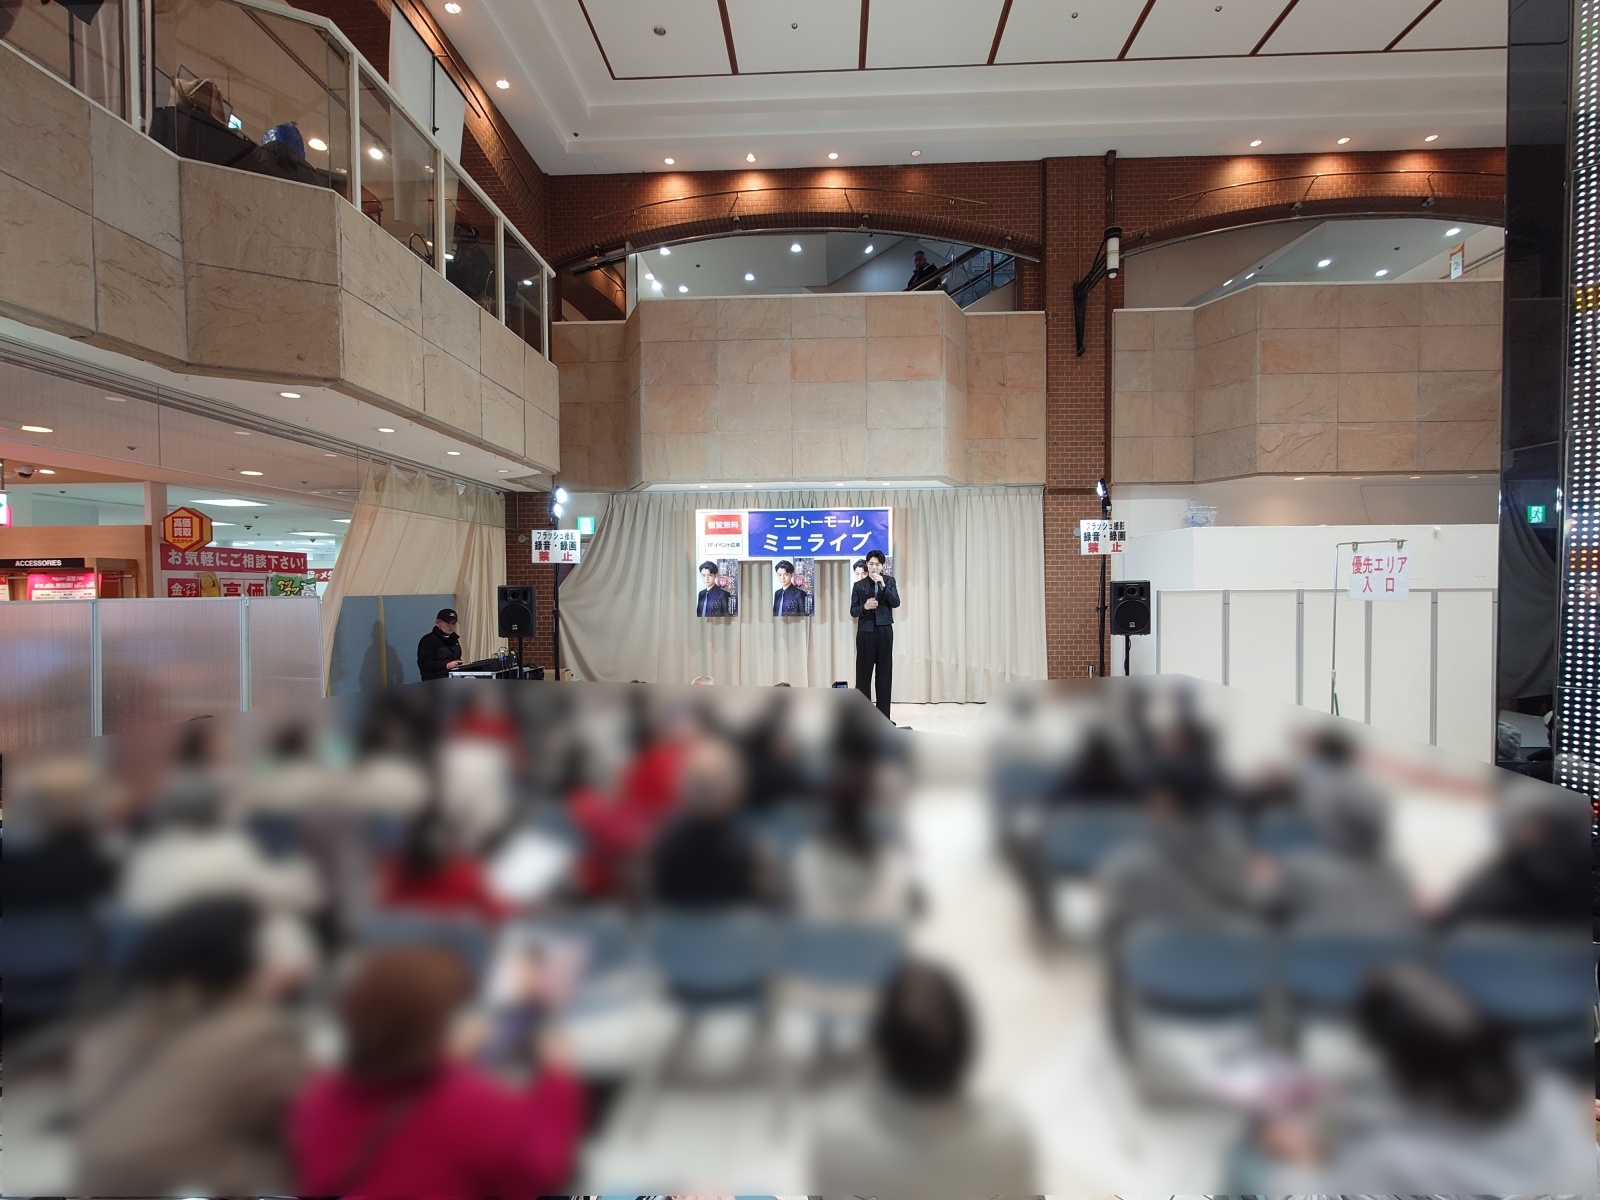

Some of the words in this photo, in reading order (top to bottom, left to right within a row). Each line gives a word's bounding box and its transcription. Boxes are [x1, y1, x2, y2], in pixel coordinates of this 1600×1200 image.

[774, 515, 864, 528] ニットーモール
[1086, 521, 1125, 530] フラッシュ撮影
[536, 532, 576, 540] フラッシュ撮影
[763, 531, 872, 552] ミニライブ
[1083, 531, 1126, 542] 録音・録画
[534, 541, 577, 551] 録音・録画
[1087, 542, 1123, 553] 禁止
[168, 549, 305, 569] お気軽にご相談下さい!
[538, 551, 573, 561] 禁止
[1352, 556, 1408, 574] 優先エリア
[1363, 576, 1394, 593] 入口
